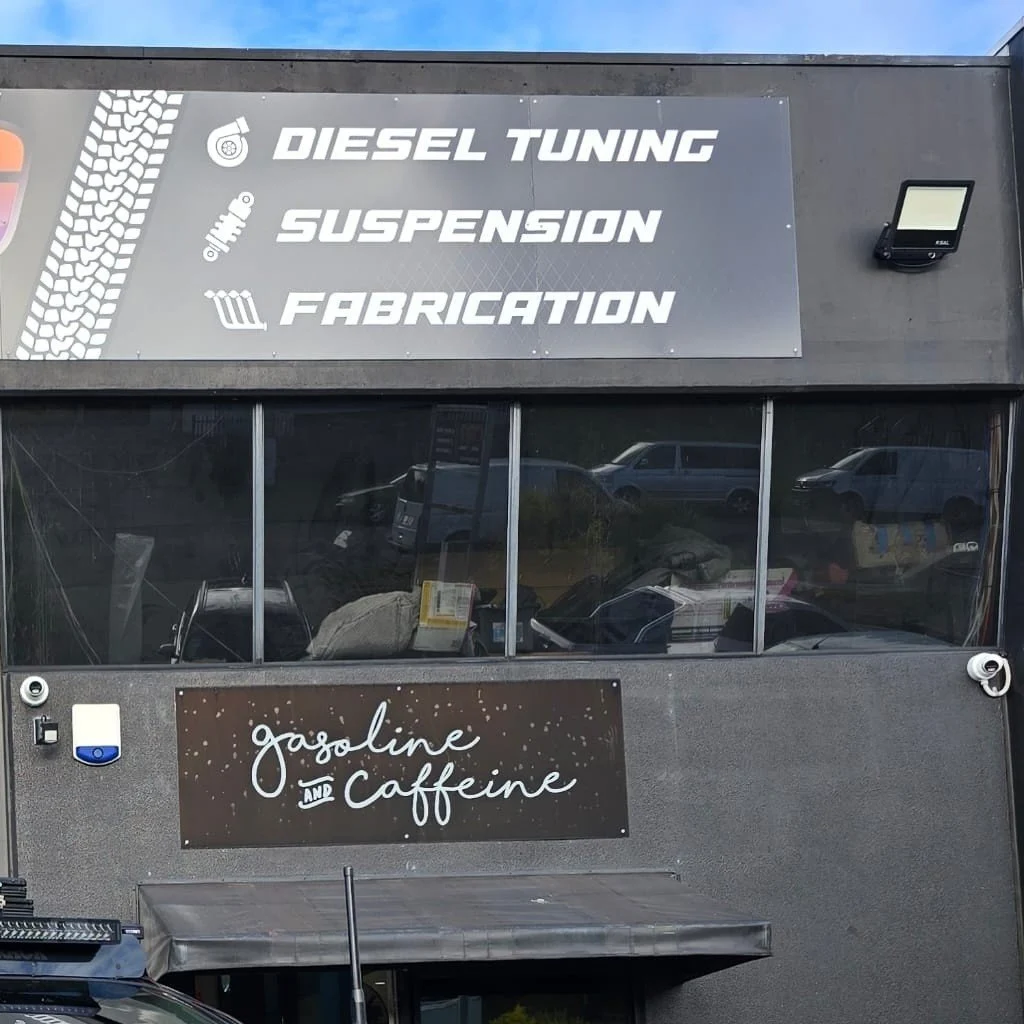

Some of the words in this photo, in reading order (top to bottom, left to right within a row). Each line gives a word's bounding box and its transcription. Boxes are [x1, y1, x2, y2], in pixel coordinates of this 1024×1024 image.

[272, 127, 487, 162] DIESEL
[506, 128, 719, 163] TUNING
[275, 208, 663, 244] SUSPENSION
[279, 289, 676, 326] FABRICATION
[250, 702, 480, 799] gasoline
[302, 783, 334, 804] AND
